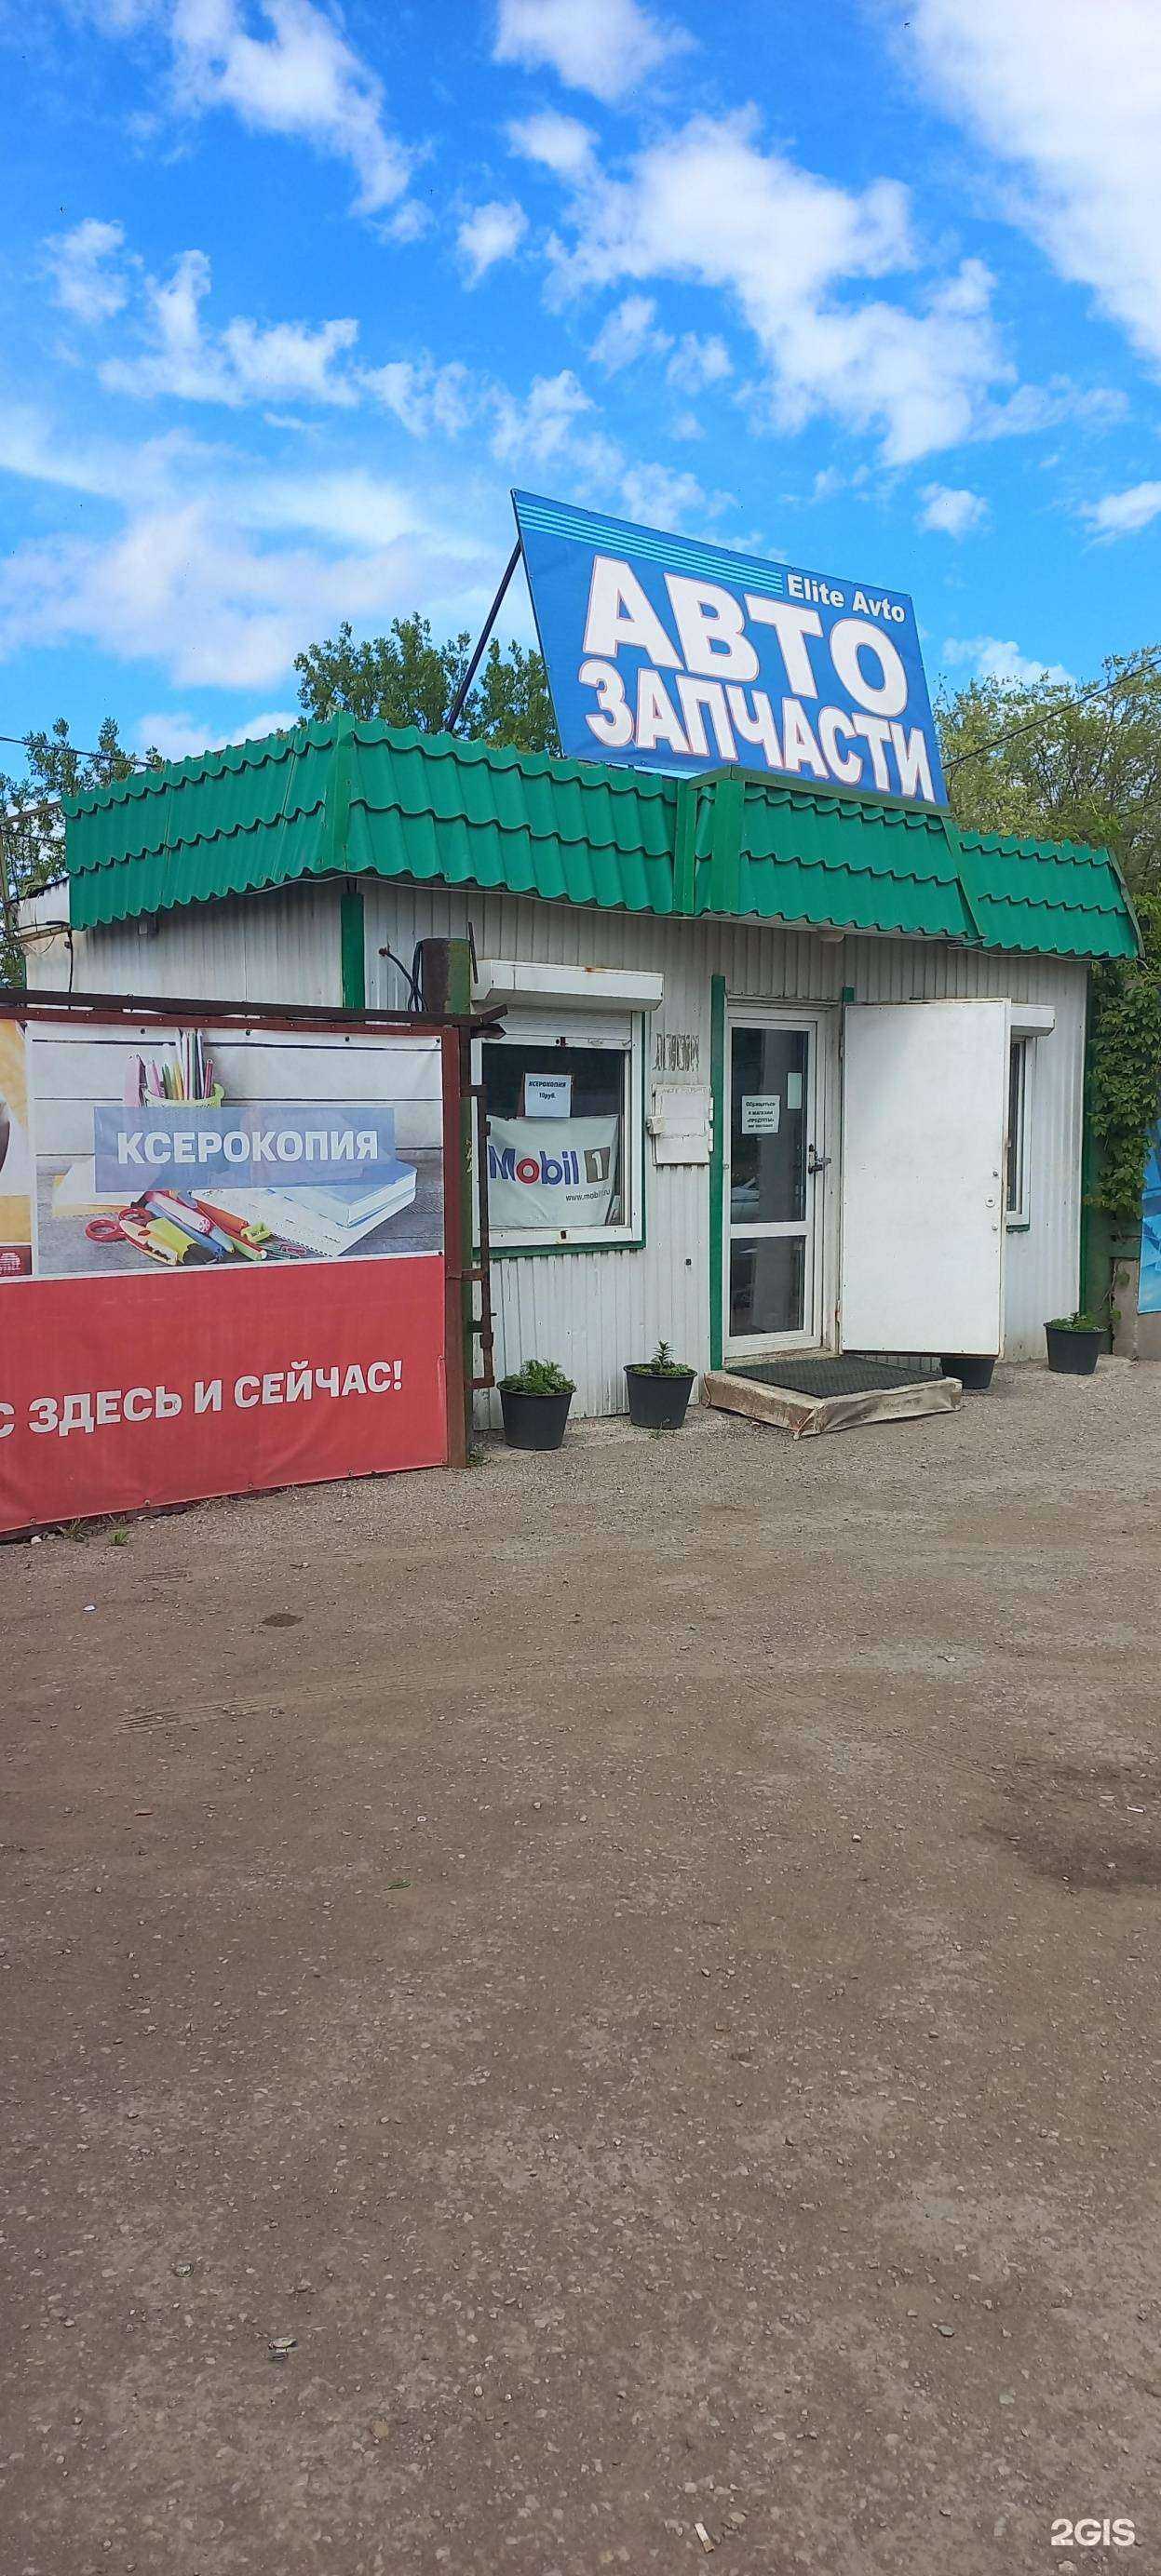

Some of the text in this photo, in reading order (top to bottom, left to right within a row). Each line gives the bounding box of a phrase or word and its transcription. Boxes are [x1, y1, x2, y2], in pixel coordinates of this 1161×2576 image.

[786, 573, 906, 624] Elite Avto
[582, 554, 909, 718] АВТО
[577, 658, 936, 804] ЗАПЧАСТИ
[117, 1130, 379, 1165] КСЕРОКОПИЯ
[488, 1144, 580, 1186] Mobil
[28, 1385, 183, 1437] ЗДЕСЬ
[194, 1379, 223, 1414] И
[234, 1360, 403, 1408] СЕЙЧАС!
